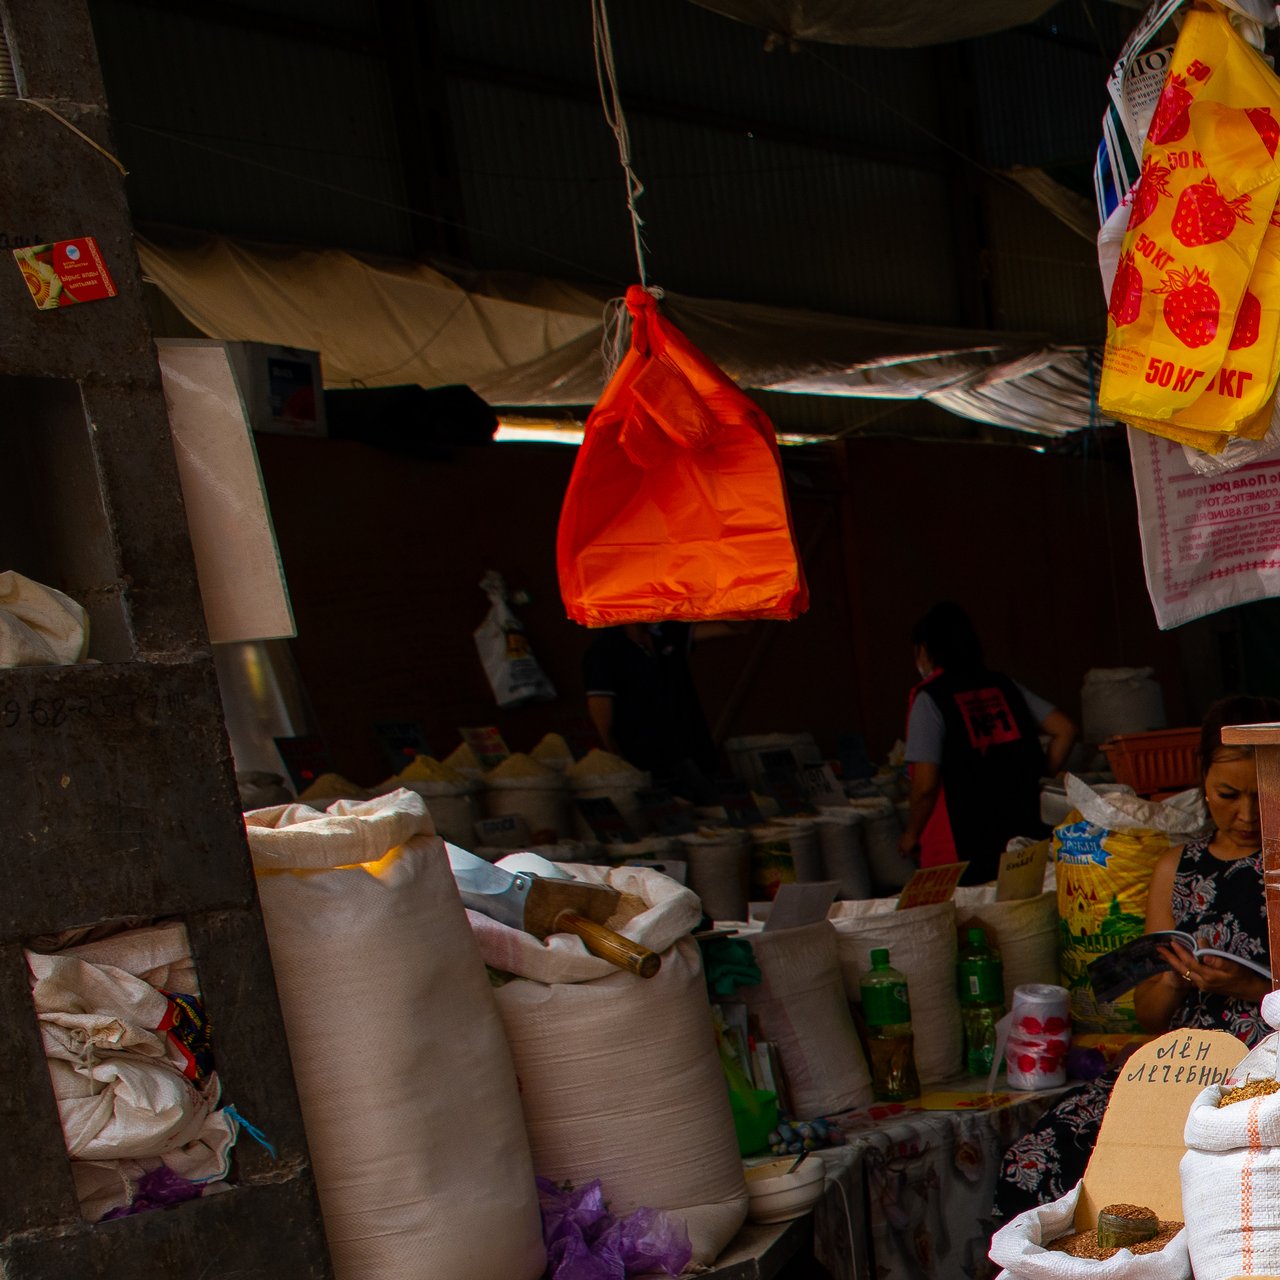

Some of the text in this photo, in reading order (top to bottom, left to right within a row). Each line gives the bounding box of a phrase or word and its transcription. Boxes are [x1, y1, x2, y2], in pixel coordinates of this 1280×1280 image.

[1186, 59, 1211, 83] 50
[1167, 152, 1187, 172] 50
[1135, 233, 1175, 272] 50 КГ
[1145, 357, 1173, 388] 50
[1172, 366, 1205, 393] КГ
[1218, 367, 1253, 399] КГ
[1156, 1036, 1211, 1062] ЛЁН
[1126, 1062, 1234, 1087] ЛЕЧЕБНЫ
